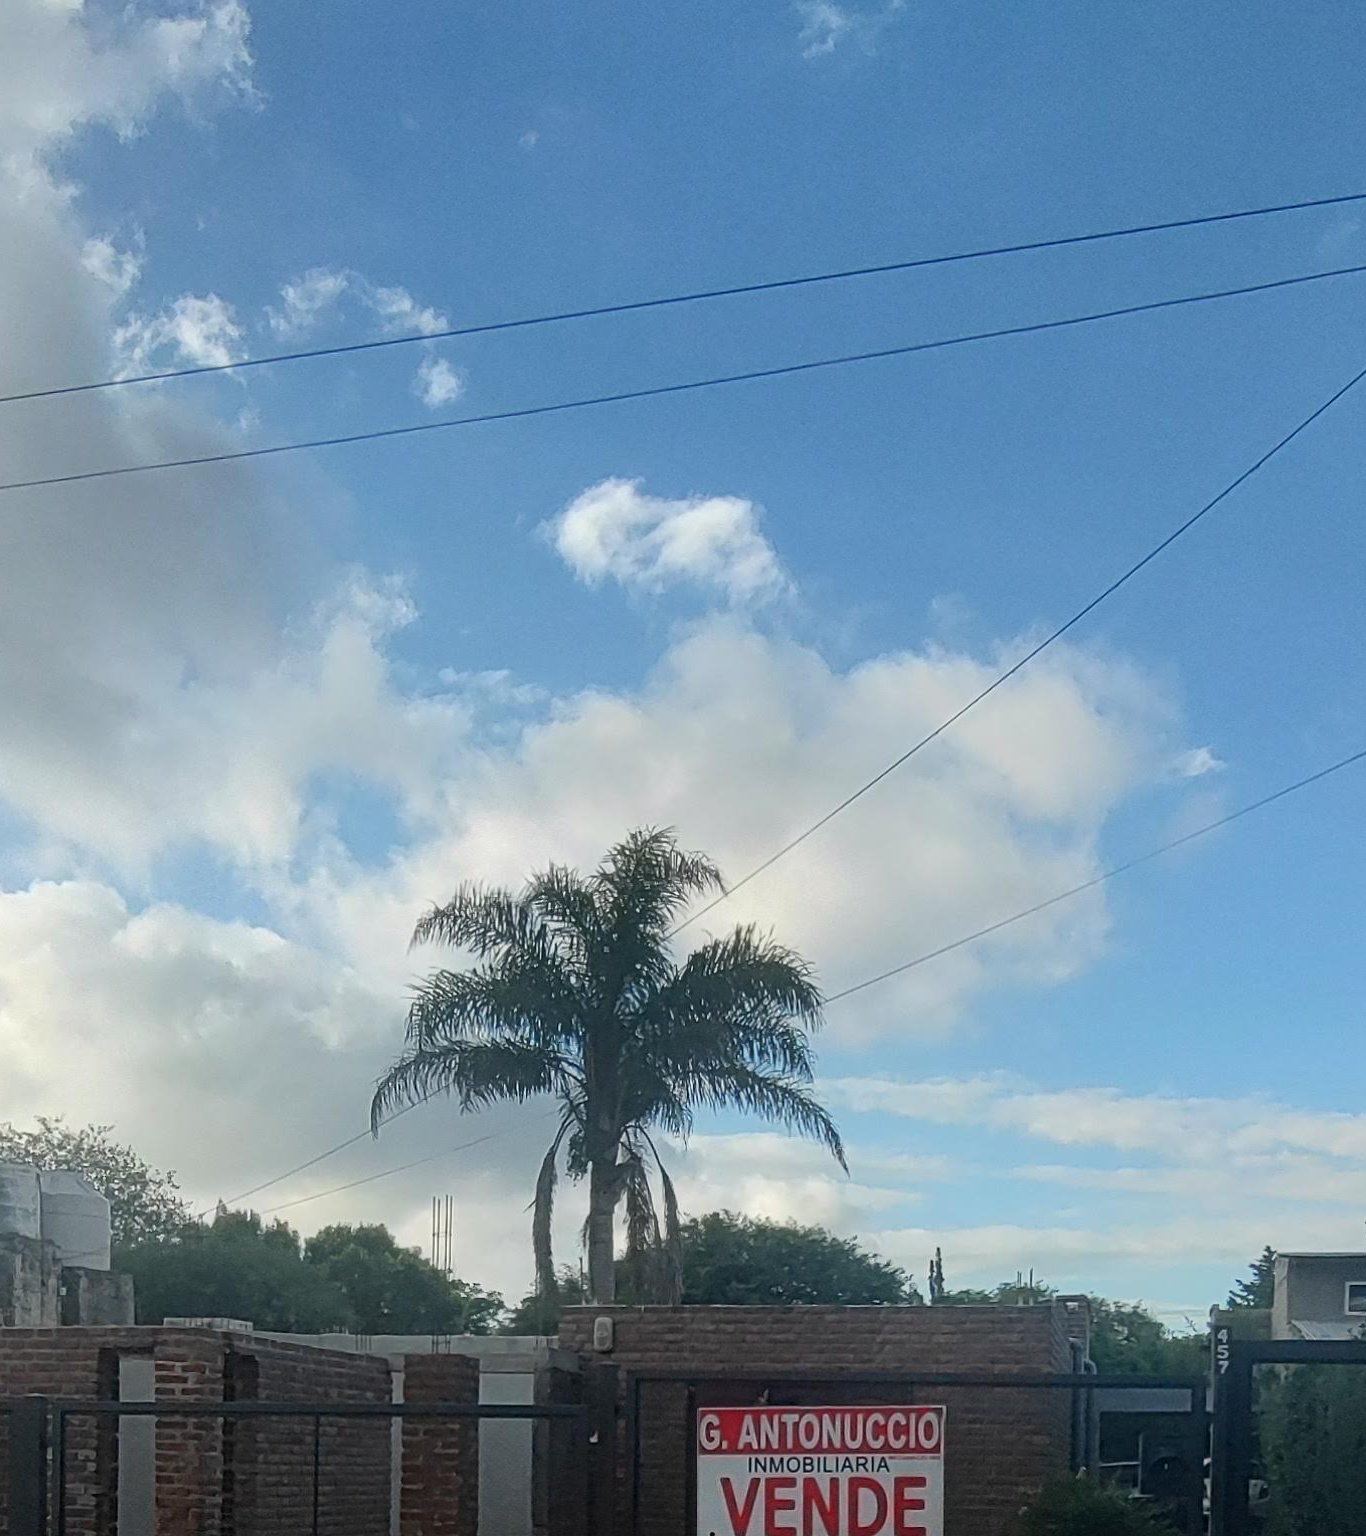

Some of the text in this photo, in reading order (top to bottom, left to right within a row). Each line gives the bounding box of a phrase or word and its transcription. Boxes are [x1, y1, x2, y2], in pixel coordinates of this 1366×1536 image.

[1216, 1328, 1230, 1375] 457
[699, 1411, 940, 1451] G. ANTONUCCIO
[747, 1456, 891, 1473] INMOBILIARIA
